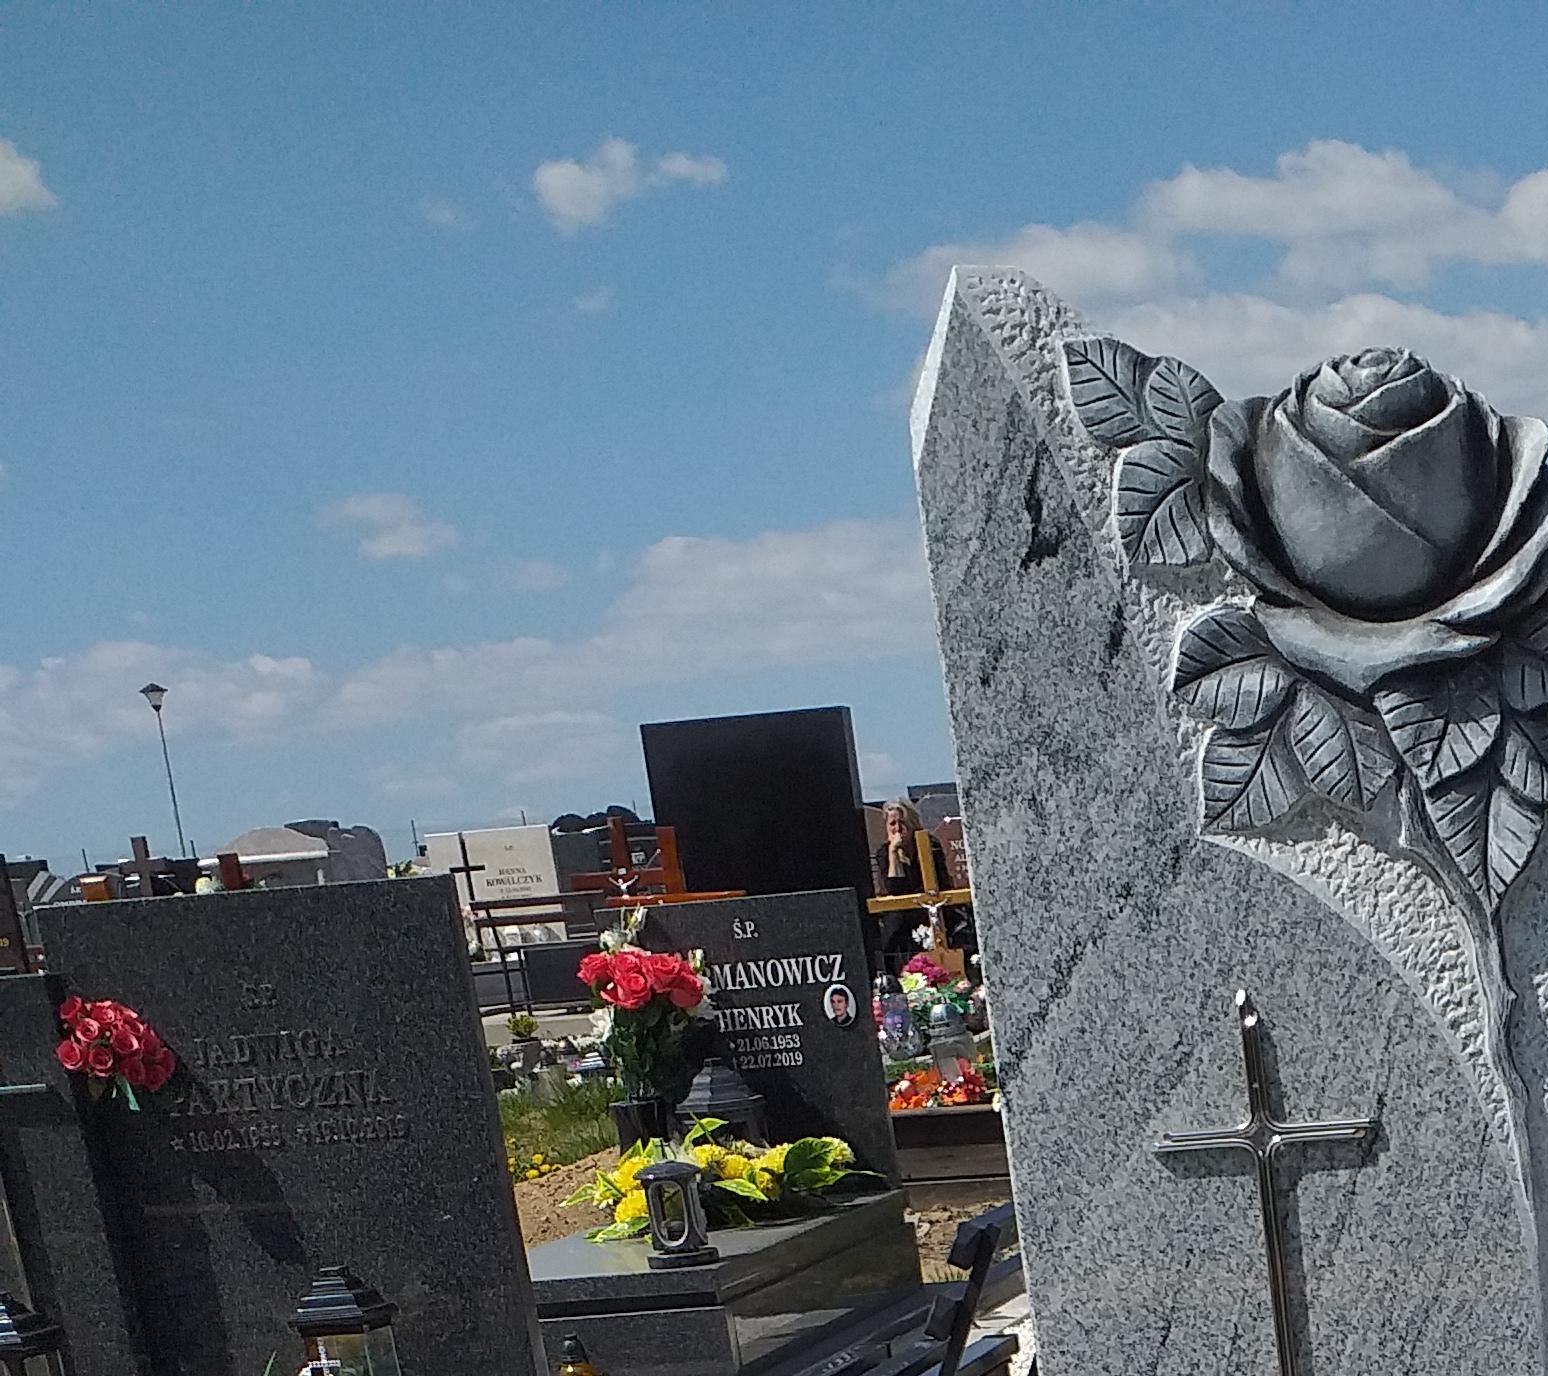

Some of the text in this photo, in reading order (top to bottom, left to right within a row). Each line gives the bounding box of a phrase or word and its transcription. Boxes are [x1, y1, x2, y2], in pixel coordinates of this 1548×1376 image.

[486, 874, 543, 888] KOWALCZYK
[712, 954, 846, 992] MANOWICZ
[718, 1003, 804, 1034] HENRYK
[736, 1033, 801, 1051] 21.06.1953
